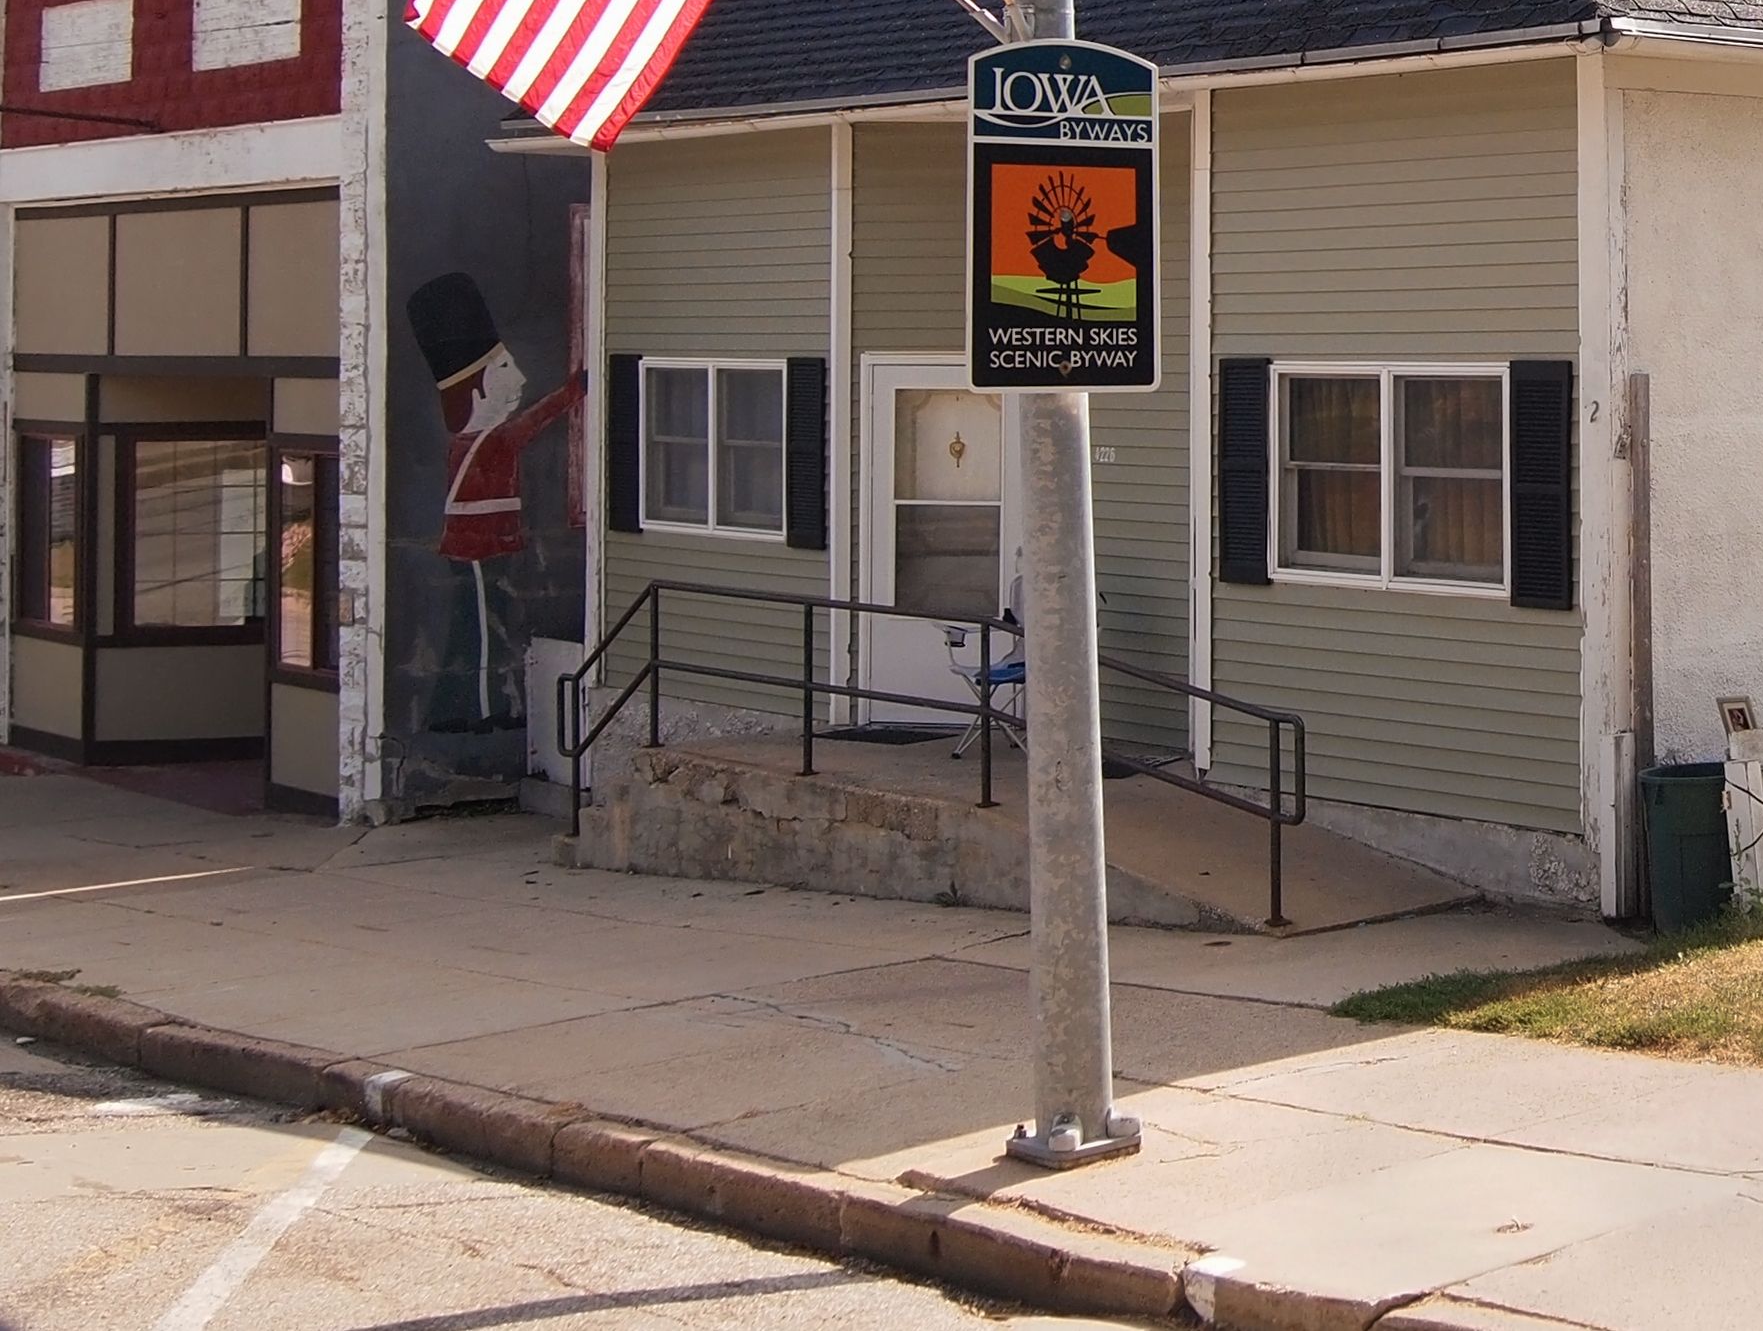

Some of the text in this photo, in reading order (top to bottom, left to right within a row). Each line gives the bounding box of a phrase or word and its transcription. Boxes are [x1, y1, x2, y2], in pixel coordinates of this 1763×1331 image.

[992, 67, 1116, 116] IOWA
[1060, 121, 1148, 143] BYWAYS
[989, 328, 1138, 345] WESTERN SKIES
[990, 350, 1138, 368] SCENIC BYWAY
